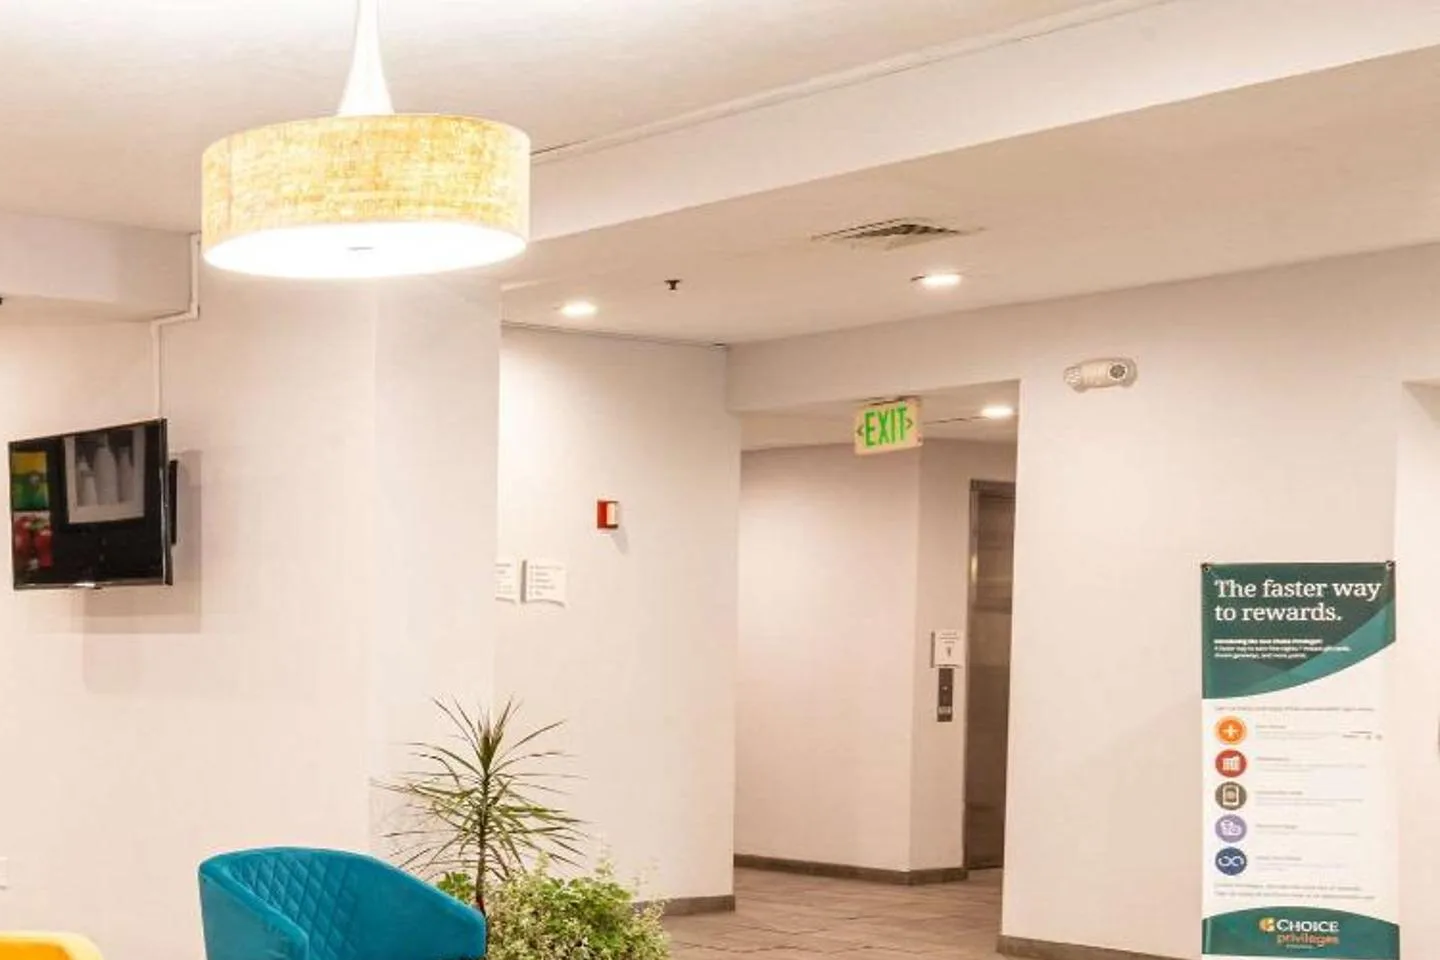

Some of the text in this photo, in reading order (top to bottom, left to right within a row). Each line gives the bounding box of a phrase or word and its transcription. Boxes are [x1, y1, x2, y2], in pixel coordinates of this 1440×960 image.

[864, 406, 908, 446] EXIT
[1213, 579, 1382, 601] The faster way
[1215, 603, 1342, 622] to rewards.
[1276, 919, 1340, 932] CHOICE
